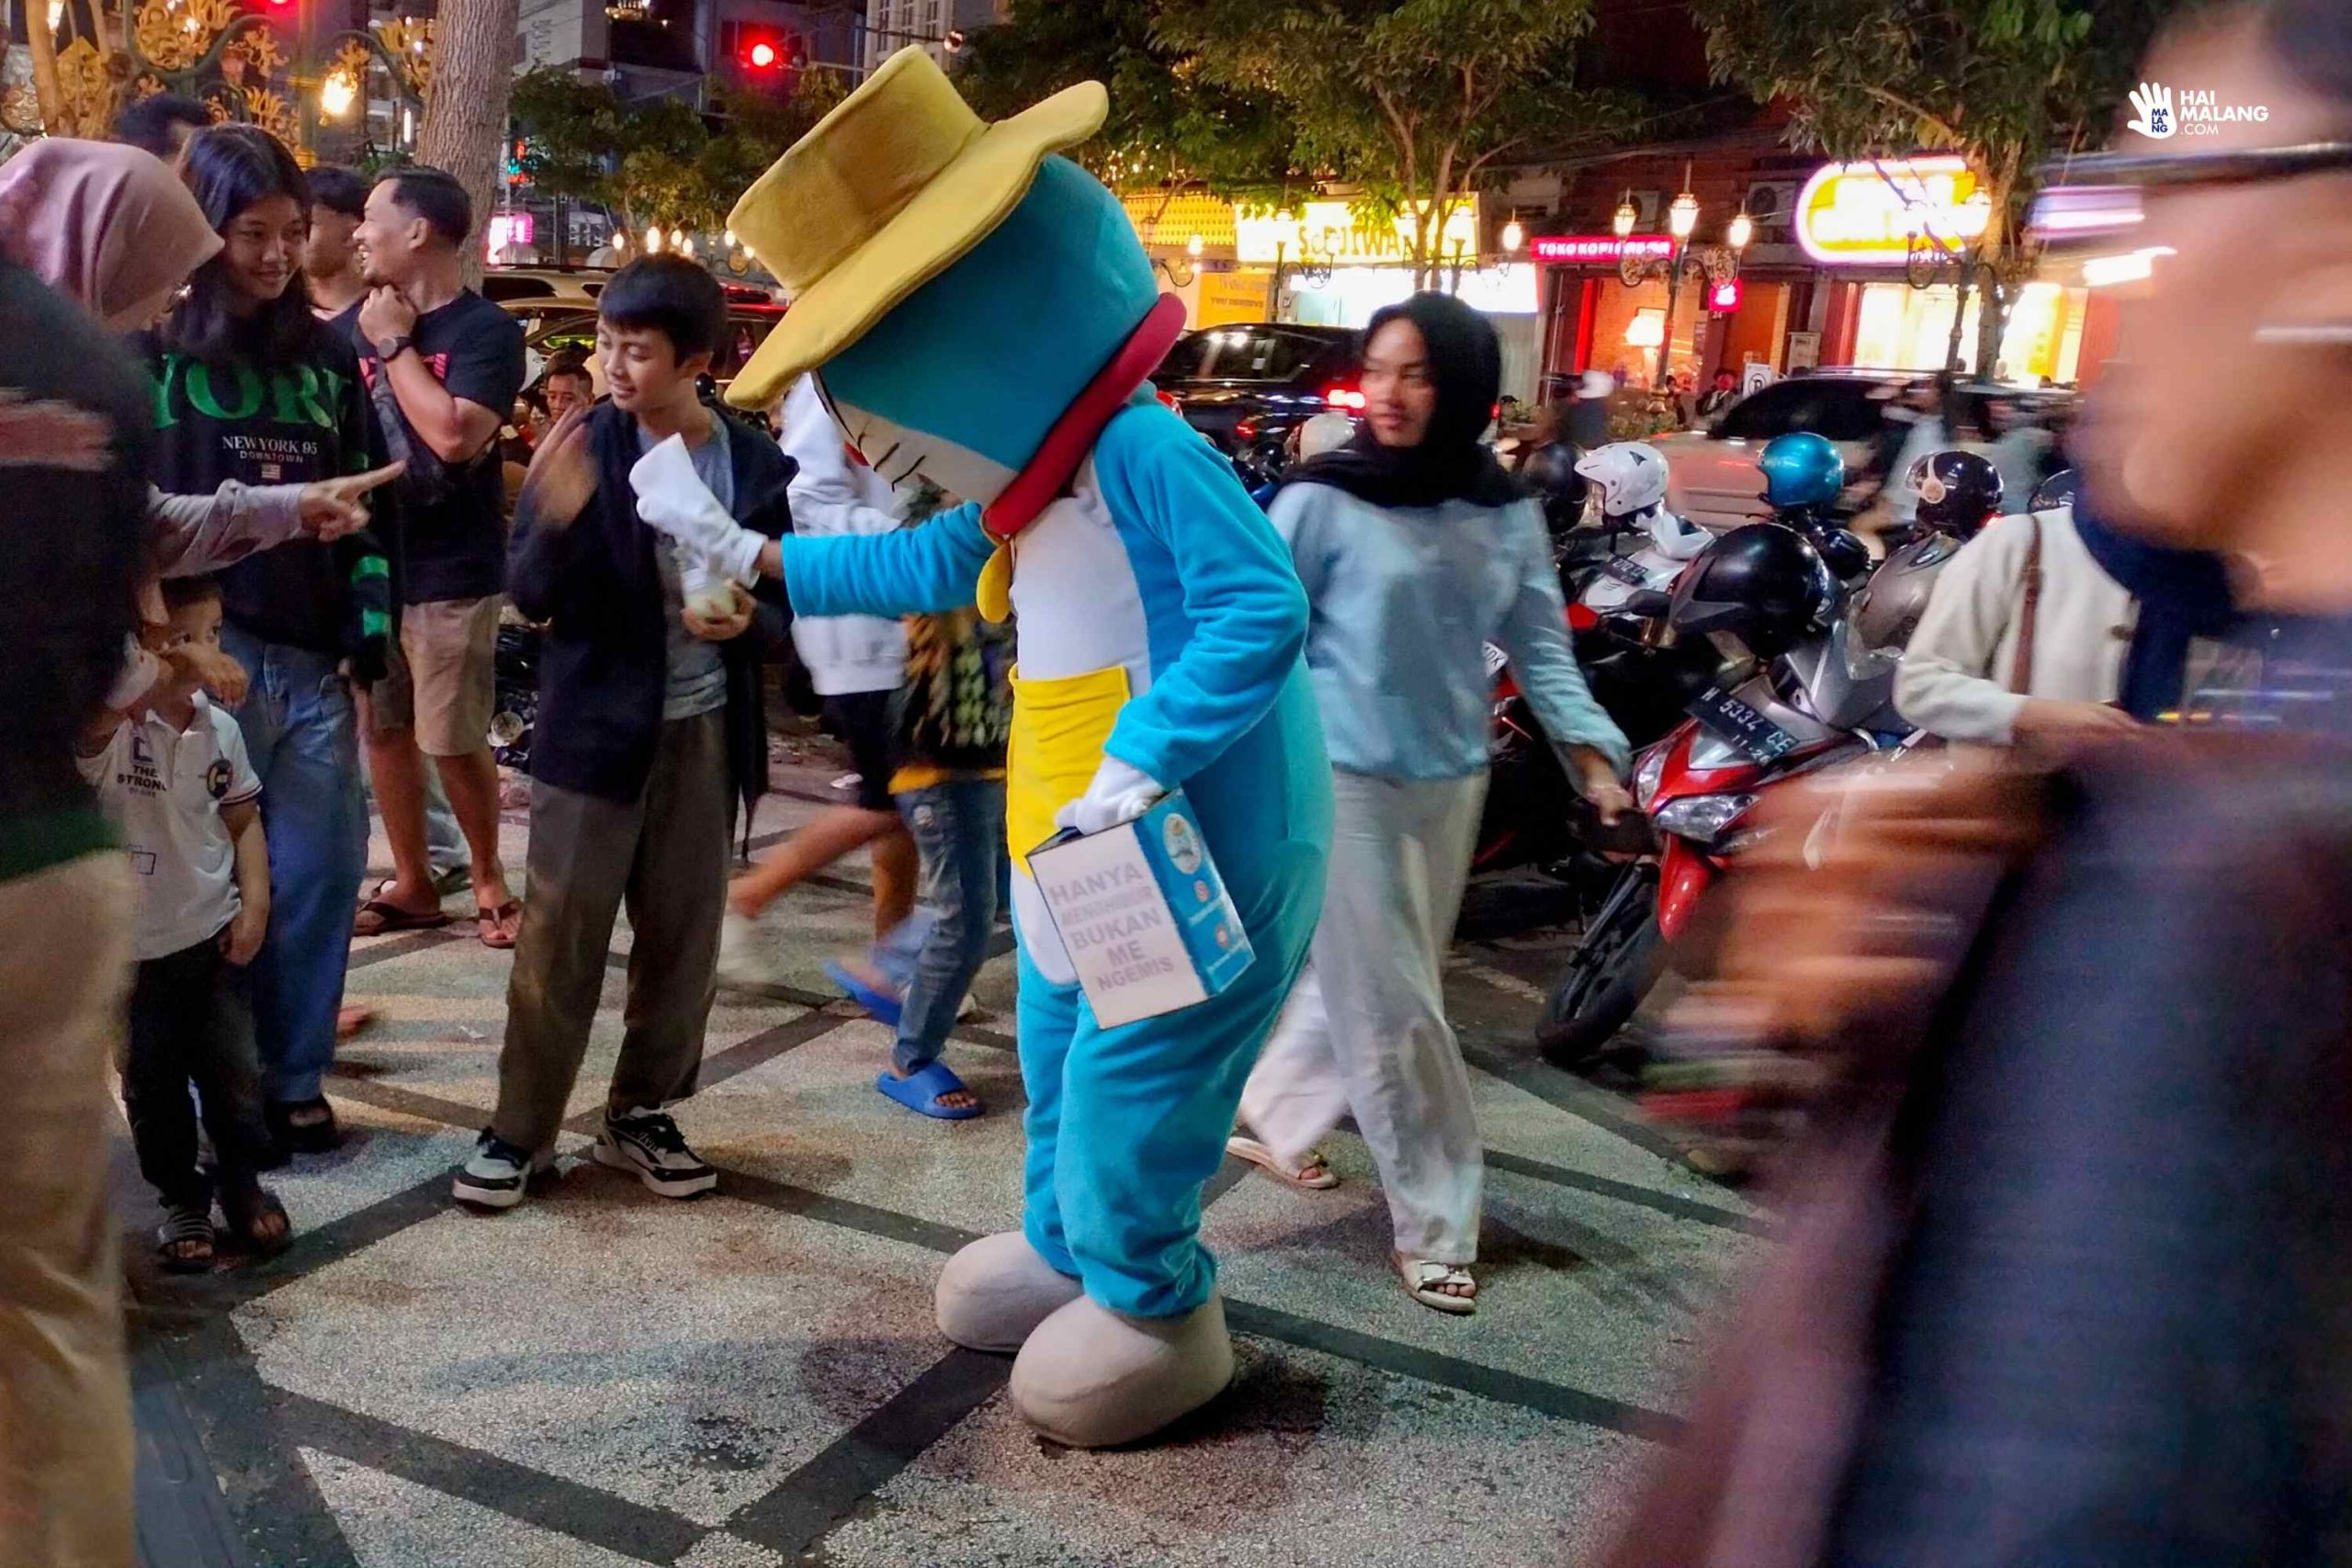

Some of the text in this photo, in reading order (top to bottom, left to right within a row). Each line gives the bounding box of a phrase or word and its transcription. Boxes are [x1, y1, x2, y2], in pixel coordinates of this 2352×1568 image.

[1539, 243, 1577, 255] TOKO
[222, 435, 319, 456] NEW YORK 95
[239, 450, 304, 464] DOWNTOWN
[1719, 699, 1766, 731] 5334
[132, 764, 158, 779] THE
[1048, 861, 1144, 908] HANYA
[1069, 906, 1166, 952] BUKAN
[1106, 939, 1147, 968] ME
[1095, 955, 1175, 993] NGEMIS
